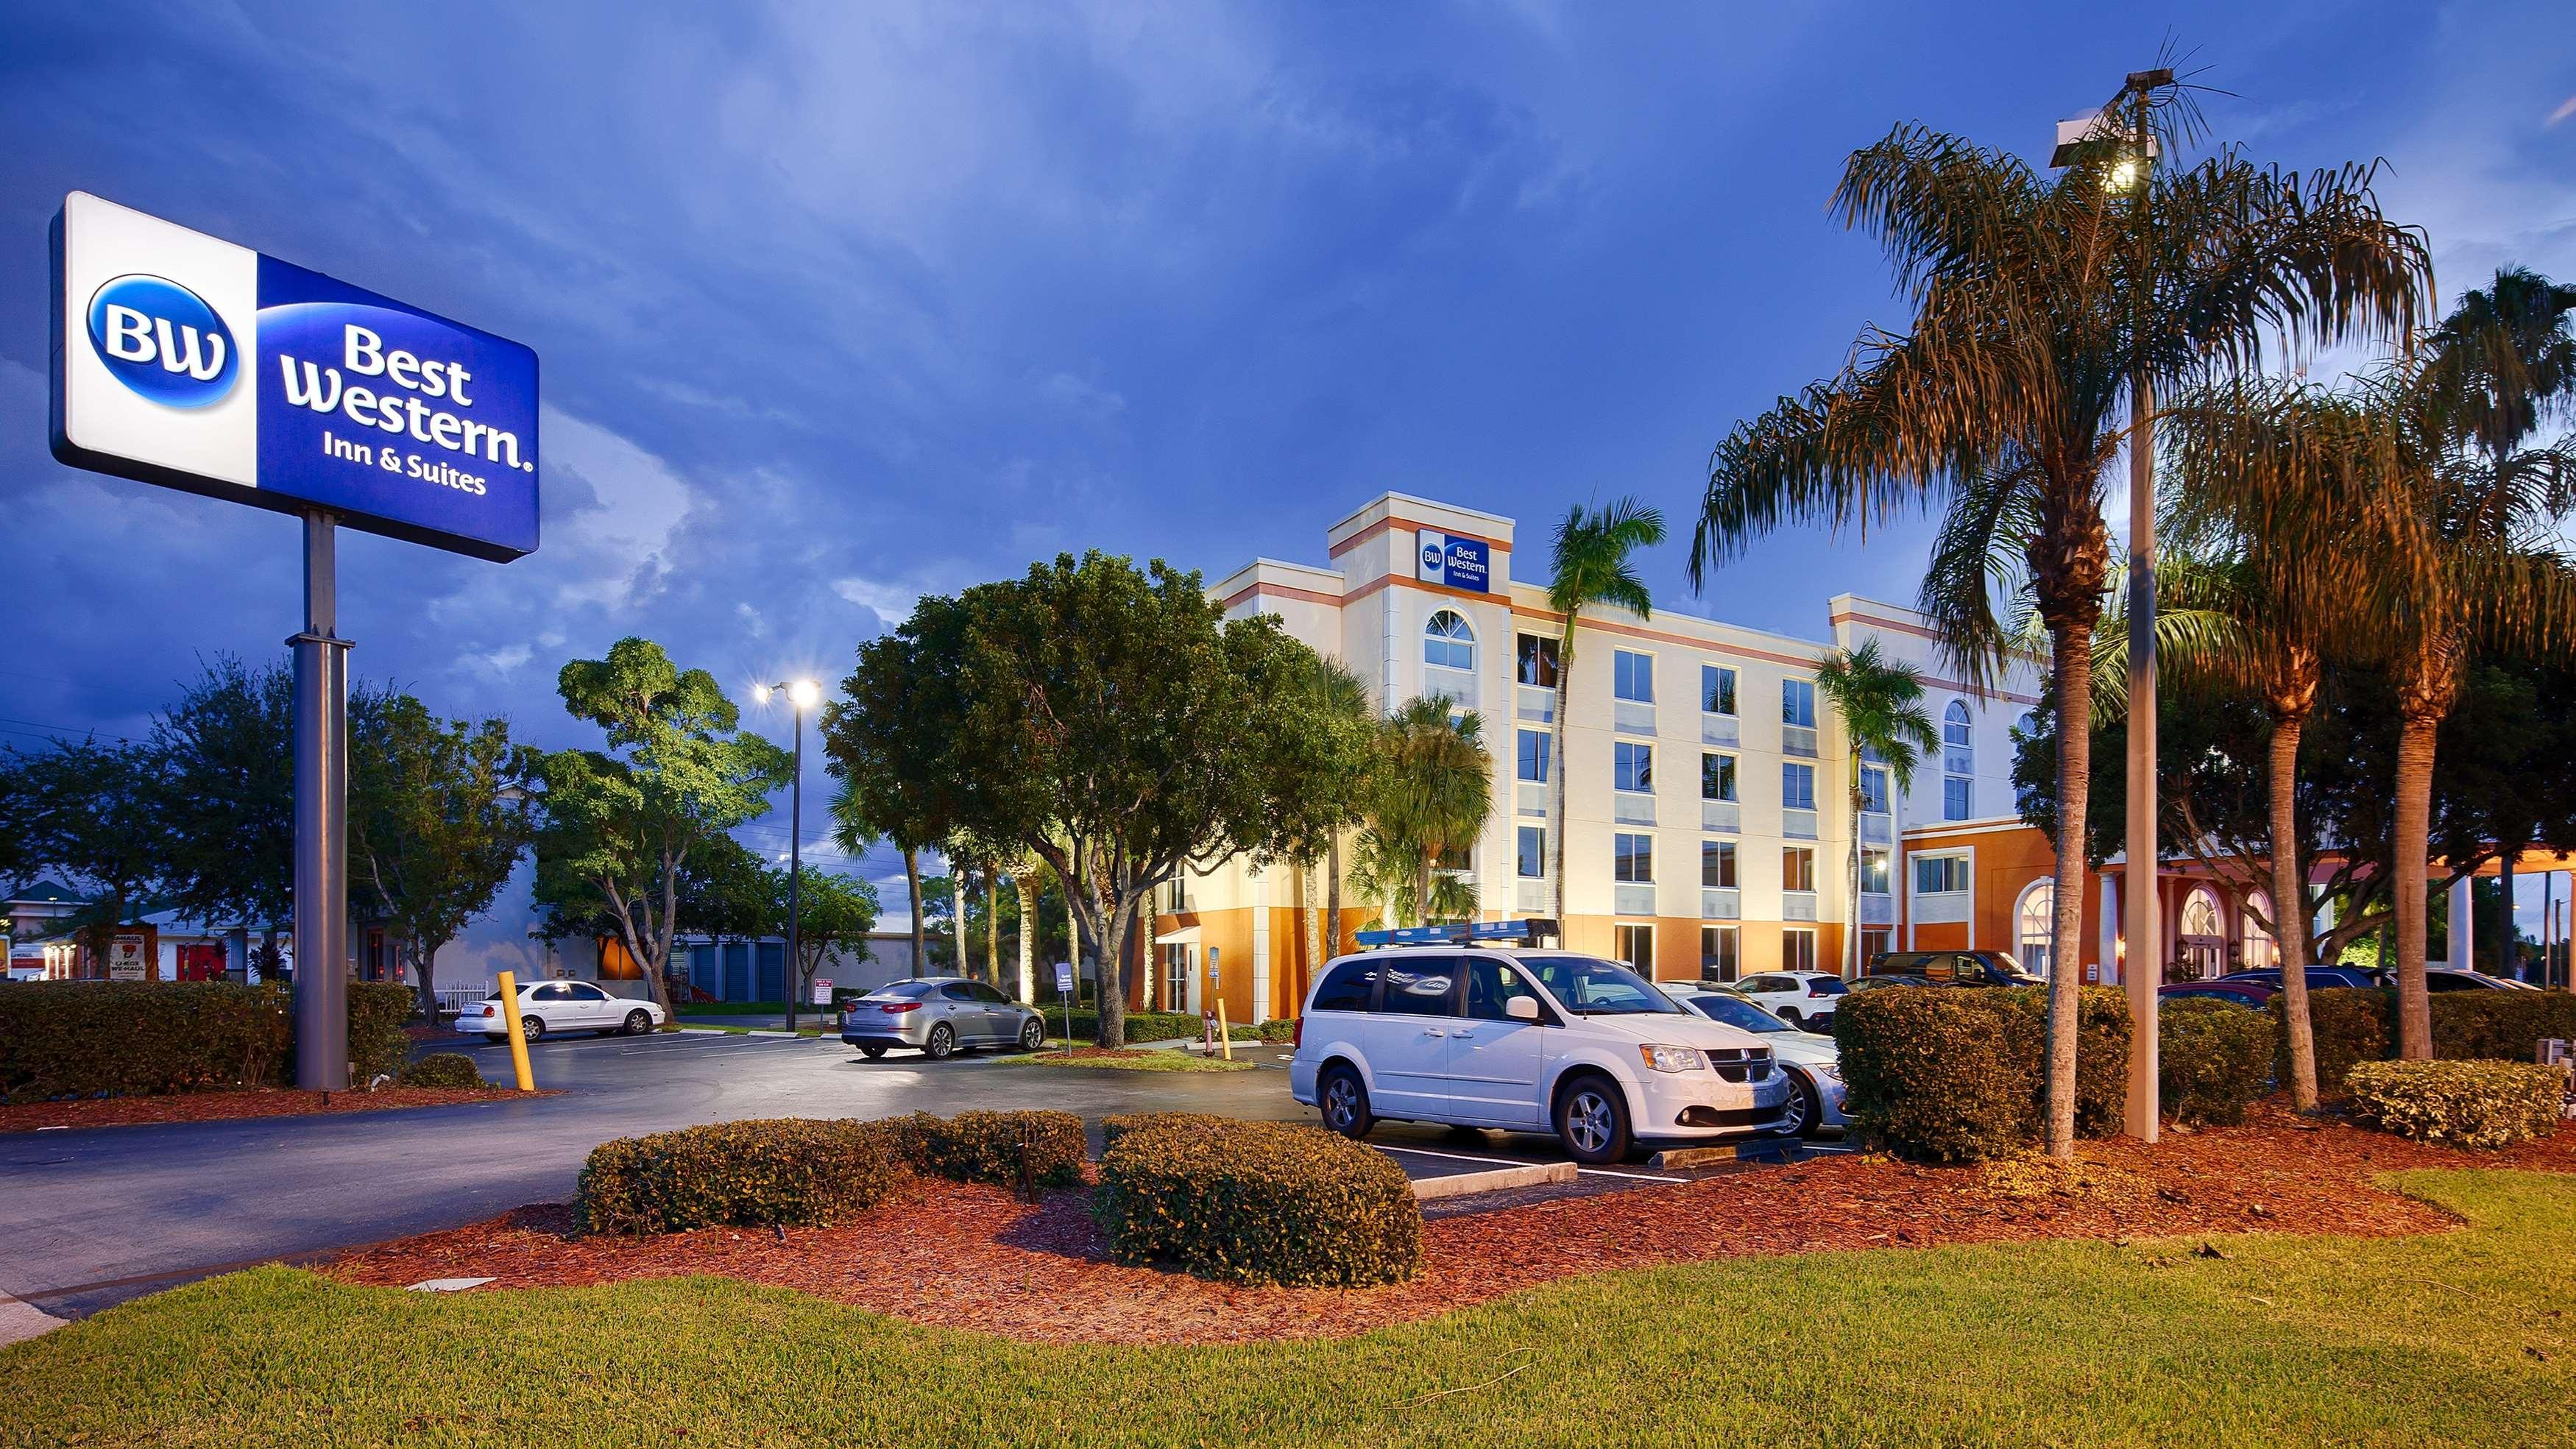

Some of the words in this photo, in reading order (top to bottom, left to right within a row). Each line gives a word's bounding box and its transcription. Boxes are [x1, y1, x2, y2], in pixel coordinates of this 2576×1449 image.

[107, 304, 225, 380] BW
[345, 324, 473, 406] Best
[324, 431, 372, 466] Inn
[380, 447, 403, 474] &
[407, 455, 486, 495] Suites
[1424, 550, 1441, 564] BW
[1457, 546, 1477, 561] Best
[1465, 573, 1479, 581] Suites
